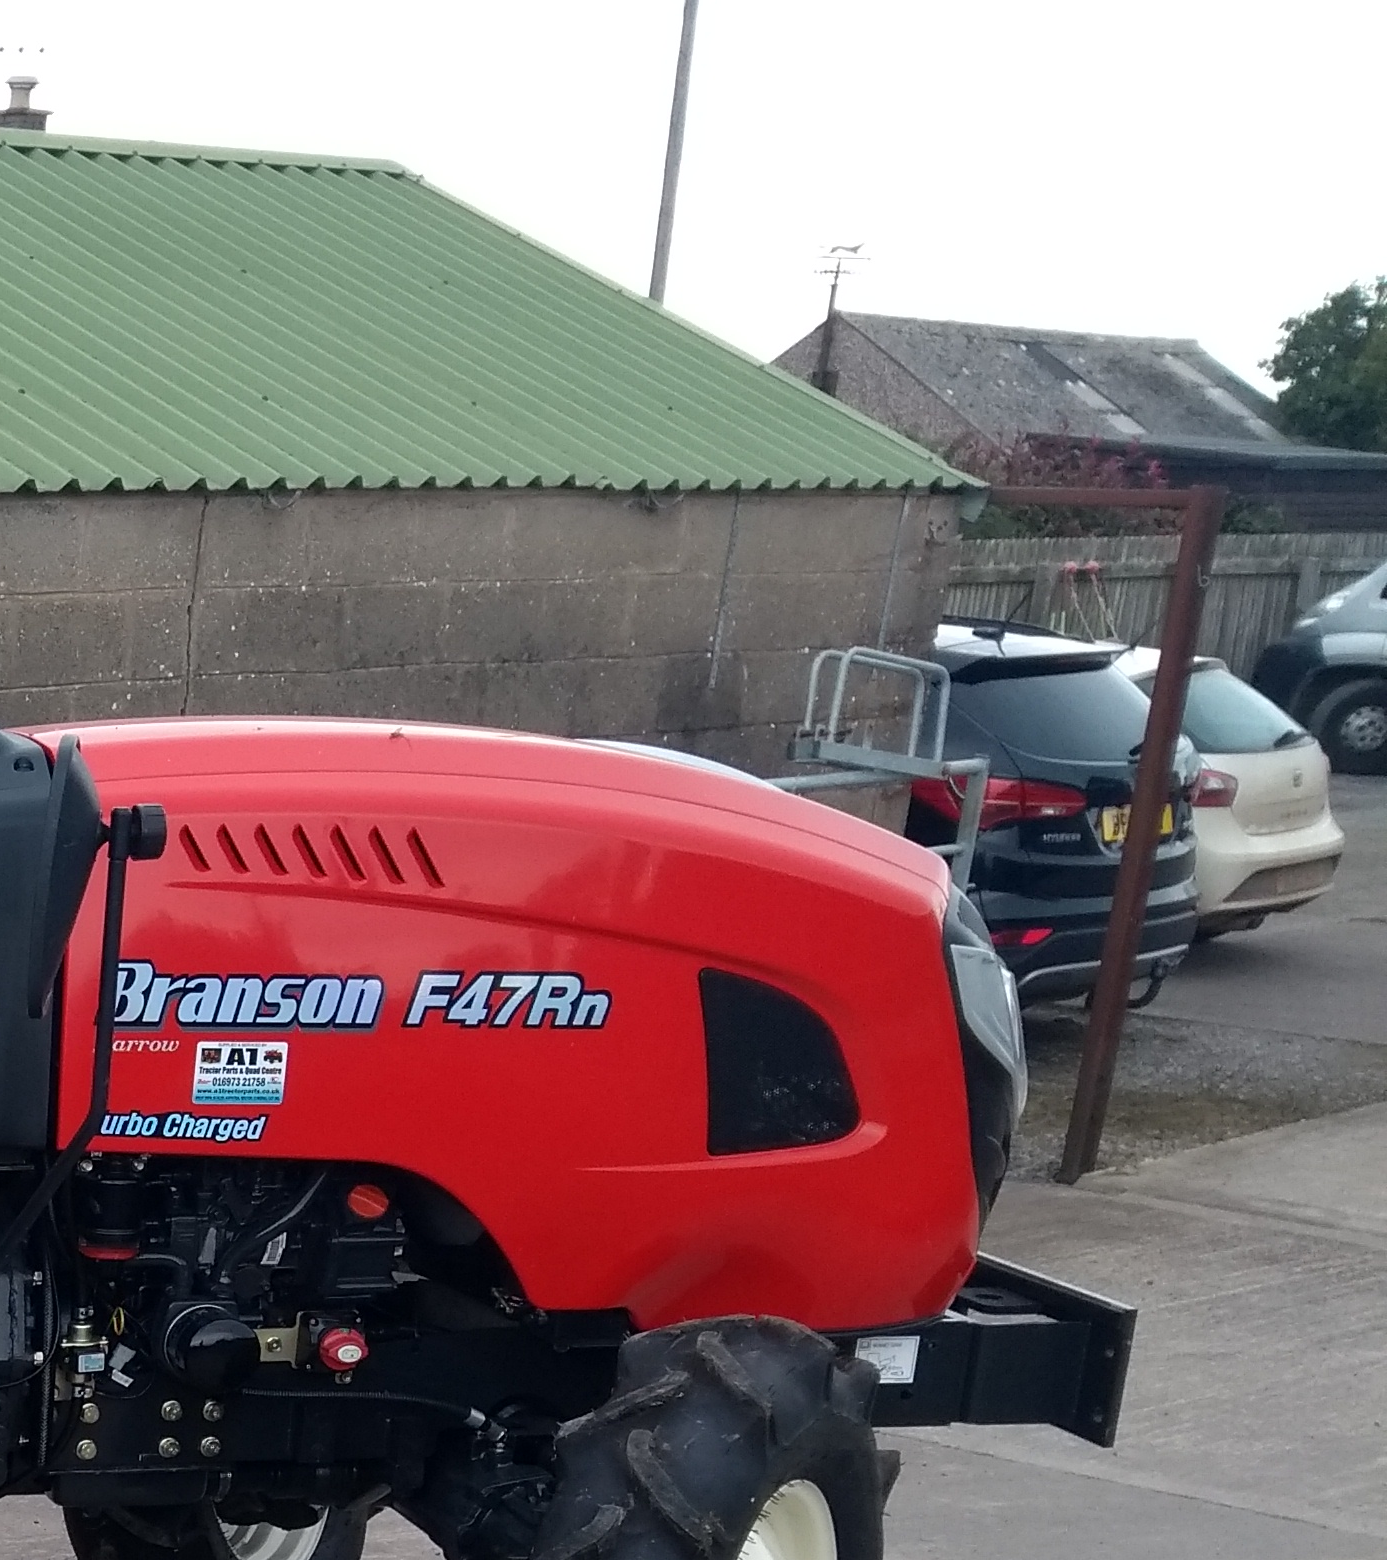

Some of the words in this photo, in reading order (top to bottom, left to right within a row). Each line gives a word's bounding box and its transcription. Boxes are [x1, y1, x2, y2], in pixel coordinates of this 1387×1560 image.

[114, 961, 384, 1026] Branson
[404, 972, 611, 1027] F47Rn
[111, 1039, 180, 1052] arrow
[226, 1048, 259, 1066] A1
[199, 1066, 222, 1074] Tractor
[245, 1067, 260, 1075] Quad
[261, 1067, 282, 1075] Centre
[212, 1077, 241, 1087] 016973
[242, 1077, 266, 1087] 21758
[100, 1112, 158, 1136] urbo
[162, 1113, 266, 1141] Charged
